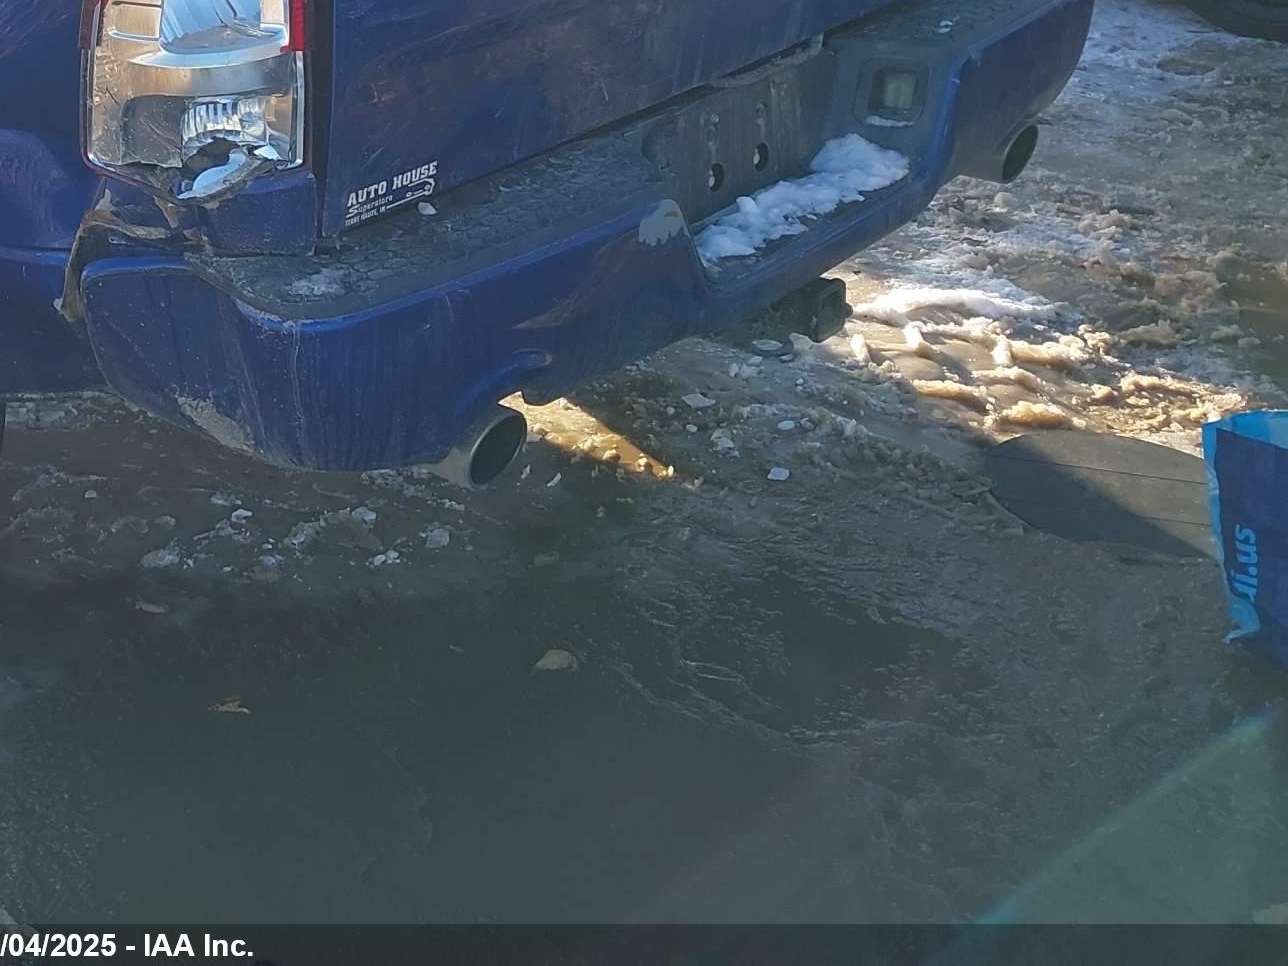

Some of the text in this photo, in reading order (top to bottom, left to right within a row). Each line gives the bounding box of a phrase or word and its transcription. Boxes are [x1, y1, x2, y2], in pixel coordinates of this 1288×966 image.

[346, 161, 438, 207] AUTO HOUSE
[345, 194, 393, 218] Superstore
